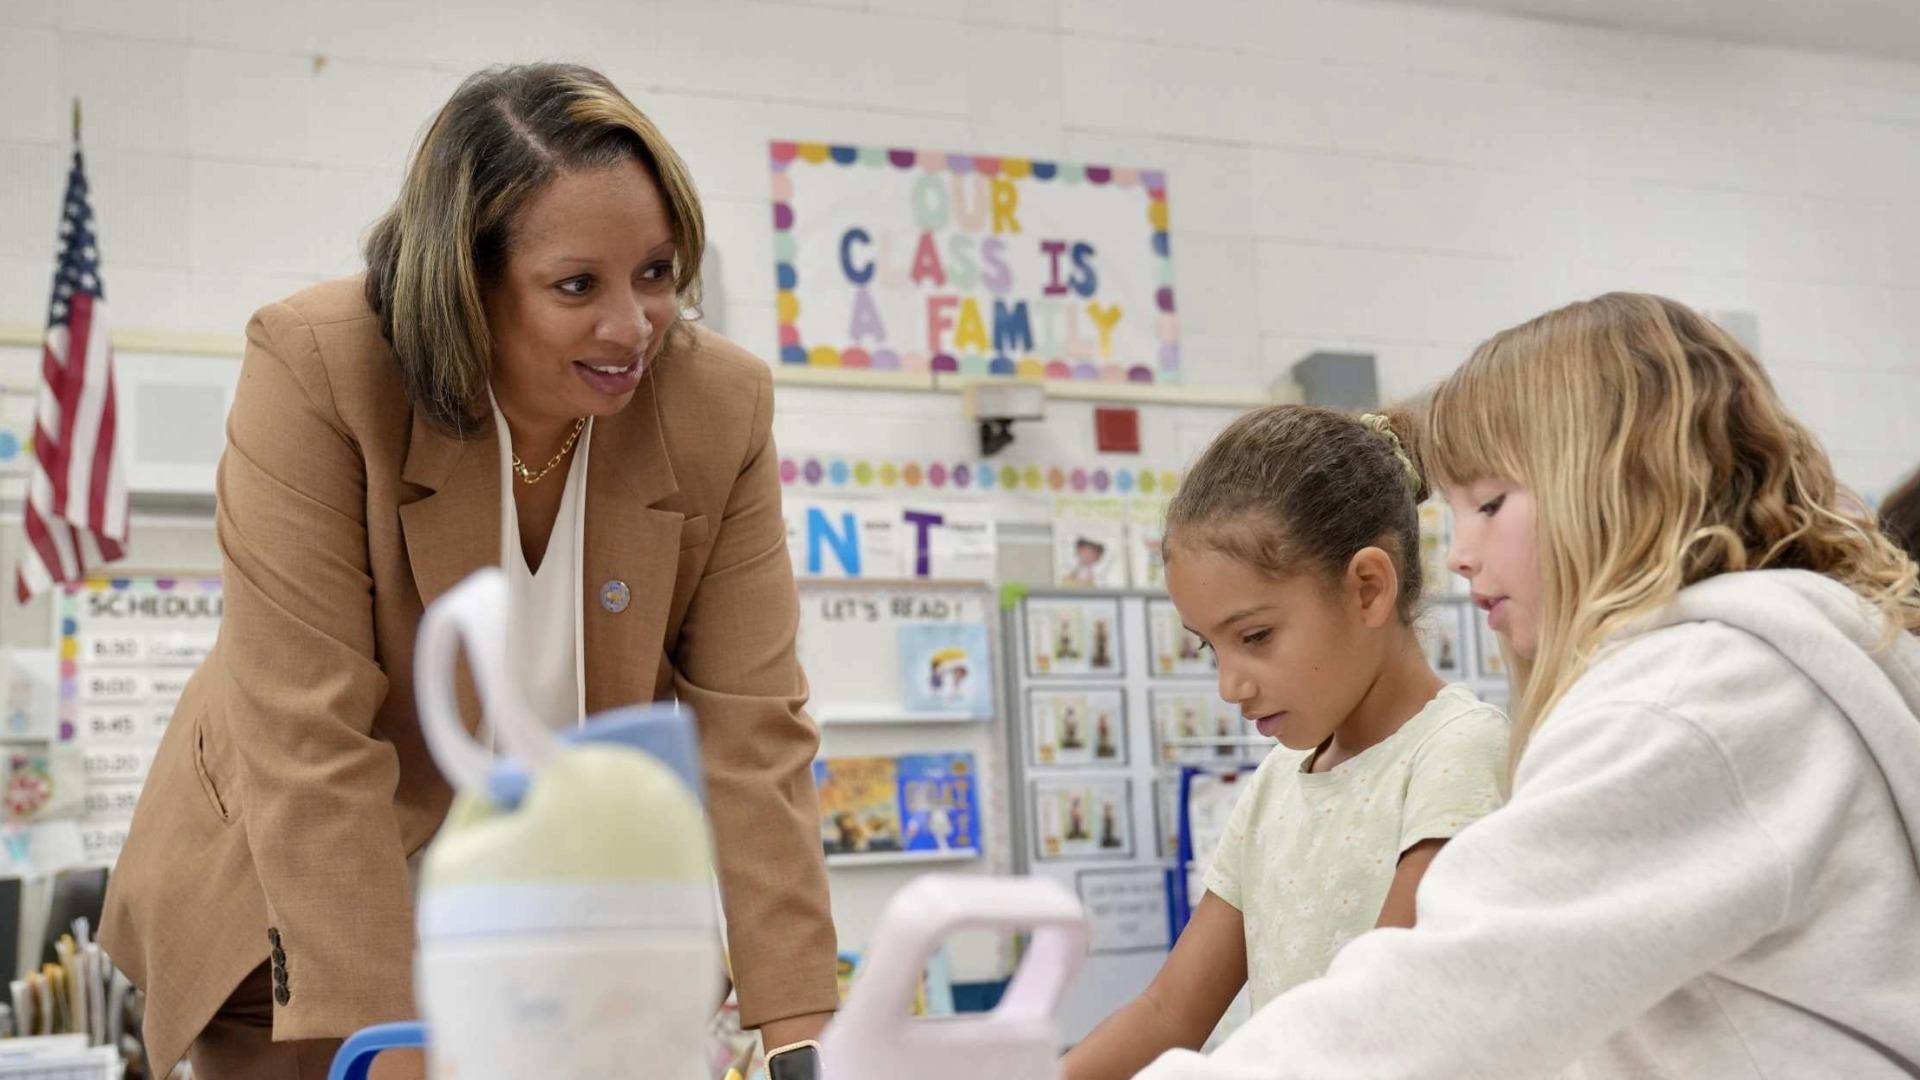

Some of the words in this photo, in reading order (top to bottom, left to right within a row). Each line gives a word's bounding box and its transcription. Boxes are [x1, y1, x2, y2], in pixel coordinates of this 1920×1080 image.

[911, 172, 1022, 234] OUR
[839, 227, 1014, 295] CLASS
[1040, 241, 1098, 297] IS
[849, 284, 886, 344] A
[926, 294, 1122, 358] FAMILY
[807, 507, 861, 576] N
[904, 510, 944, 576] T
[821, 598, 879, 622] LET'S
